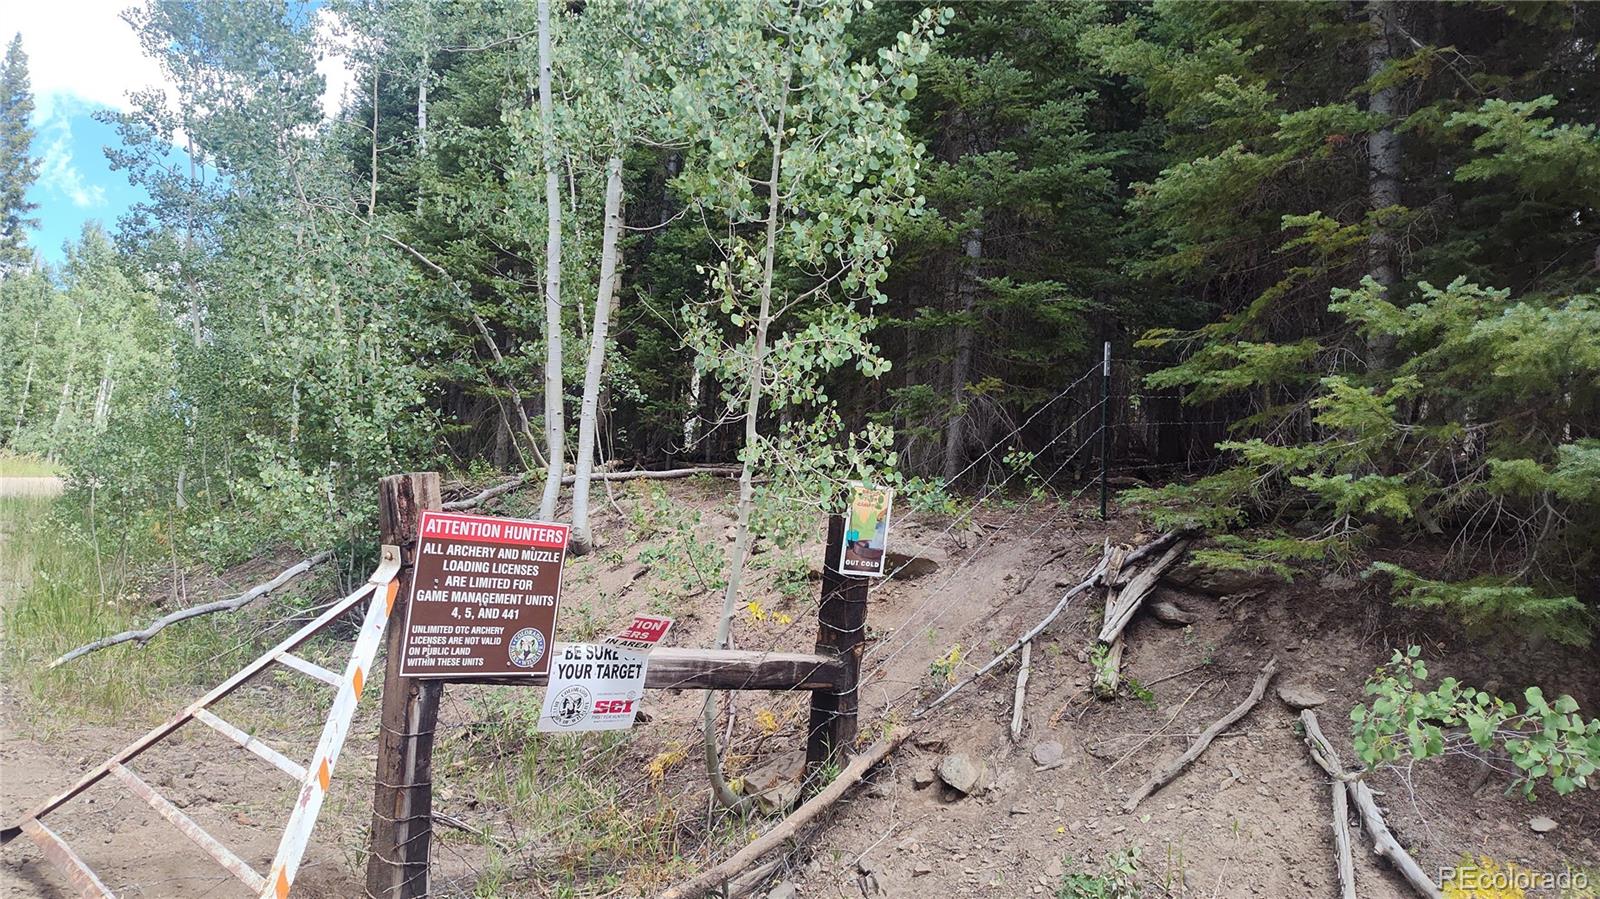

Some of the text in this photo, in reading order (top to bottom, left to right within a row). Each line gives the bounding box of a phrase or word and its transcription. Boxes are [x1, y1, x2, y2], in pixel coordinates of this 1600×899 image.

[426, 518, 563, 544] ATTENTION HUNTERS
[423, 543, 560, 563] ALL ARCHERY AND MUZZLE
[443, 560, 539, 576] LOADING LICENSES
[861, 560, 879, 568] COLD
[445, 575, 533, 590] ARE LIMITED FOR
[416, 589, 554, 606] GAME MANAGEMENT UNITS
[451, 607, 519, 620] 4, 5, AND 441
[412, 625, 504, 635] UNLIMITED OTC ARCHERY
[410, 636, 502, 645] LICENSES ARE NOT VALID
[604, 637, 653, 649] IN AREA!
[408, 647, 471, 656] ON PUBLIC LAND
[564, 645, 582, 660] BE
[407, 658, 484, 667] WITHIN THESE UNITS
[558, 663, 642, 680] YOUR TARGET
[592, 700, 633, 714] SCI
